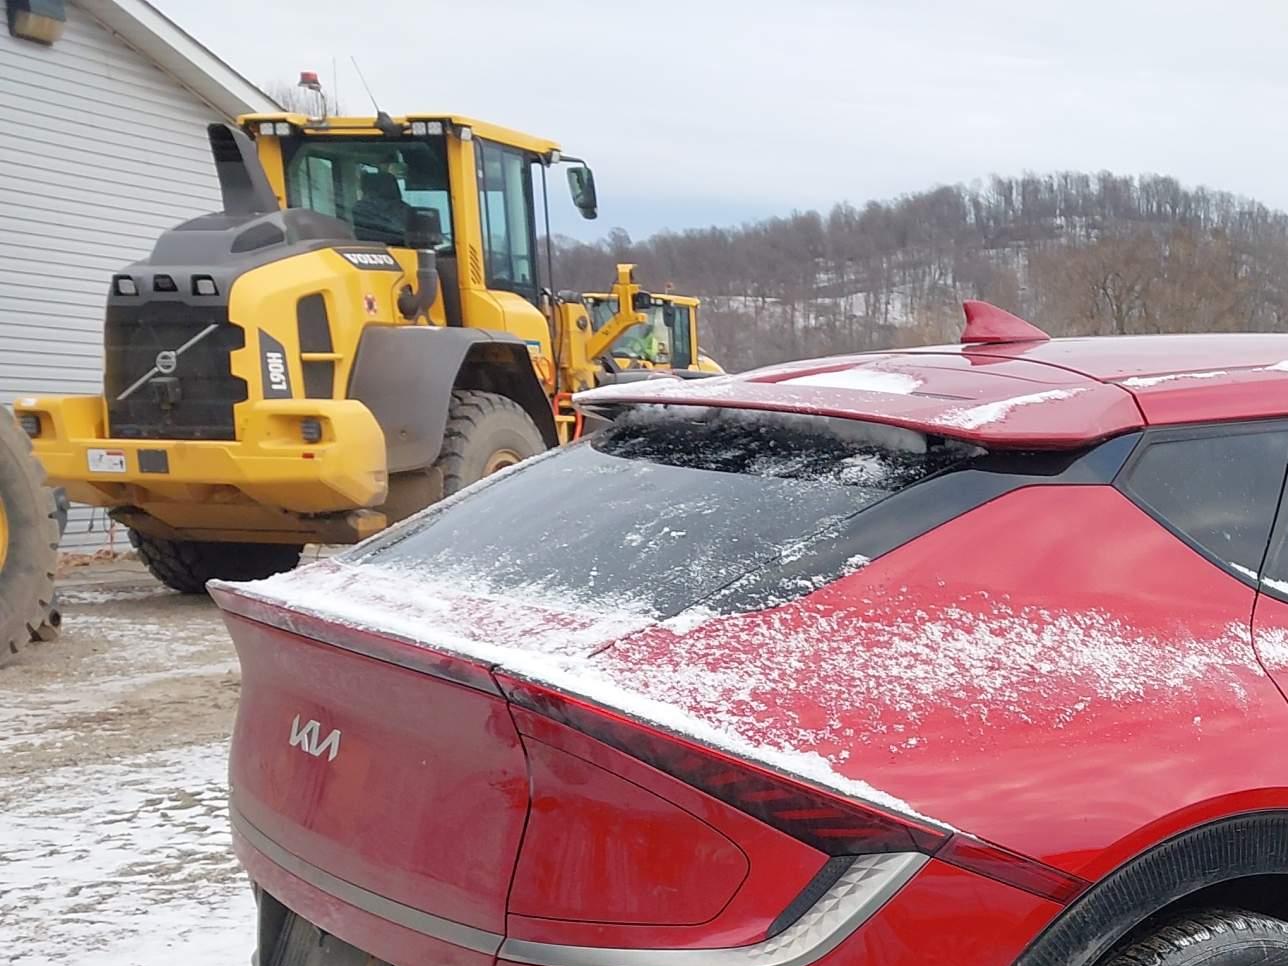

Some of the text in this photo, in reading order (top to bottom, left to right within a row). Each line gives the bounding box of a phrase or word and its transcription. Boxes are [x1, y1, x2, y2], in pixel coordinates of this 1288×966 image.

[343, 253, 394, 265] VOLVO
[266, 352, 288, 390] L90H
[289, 713, 341, 762] KIA
